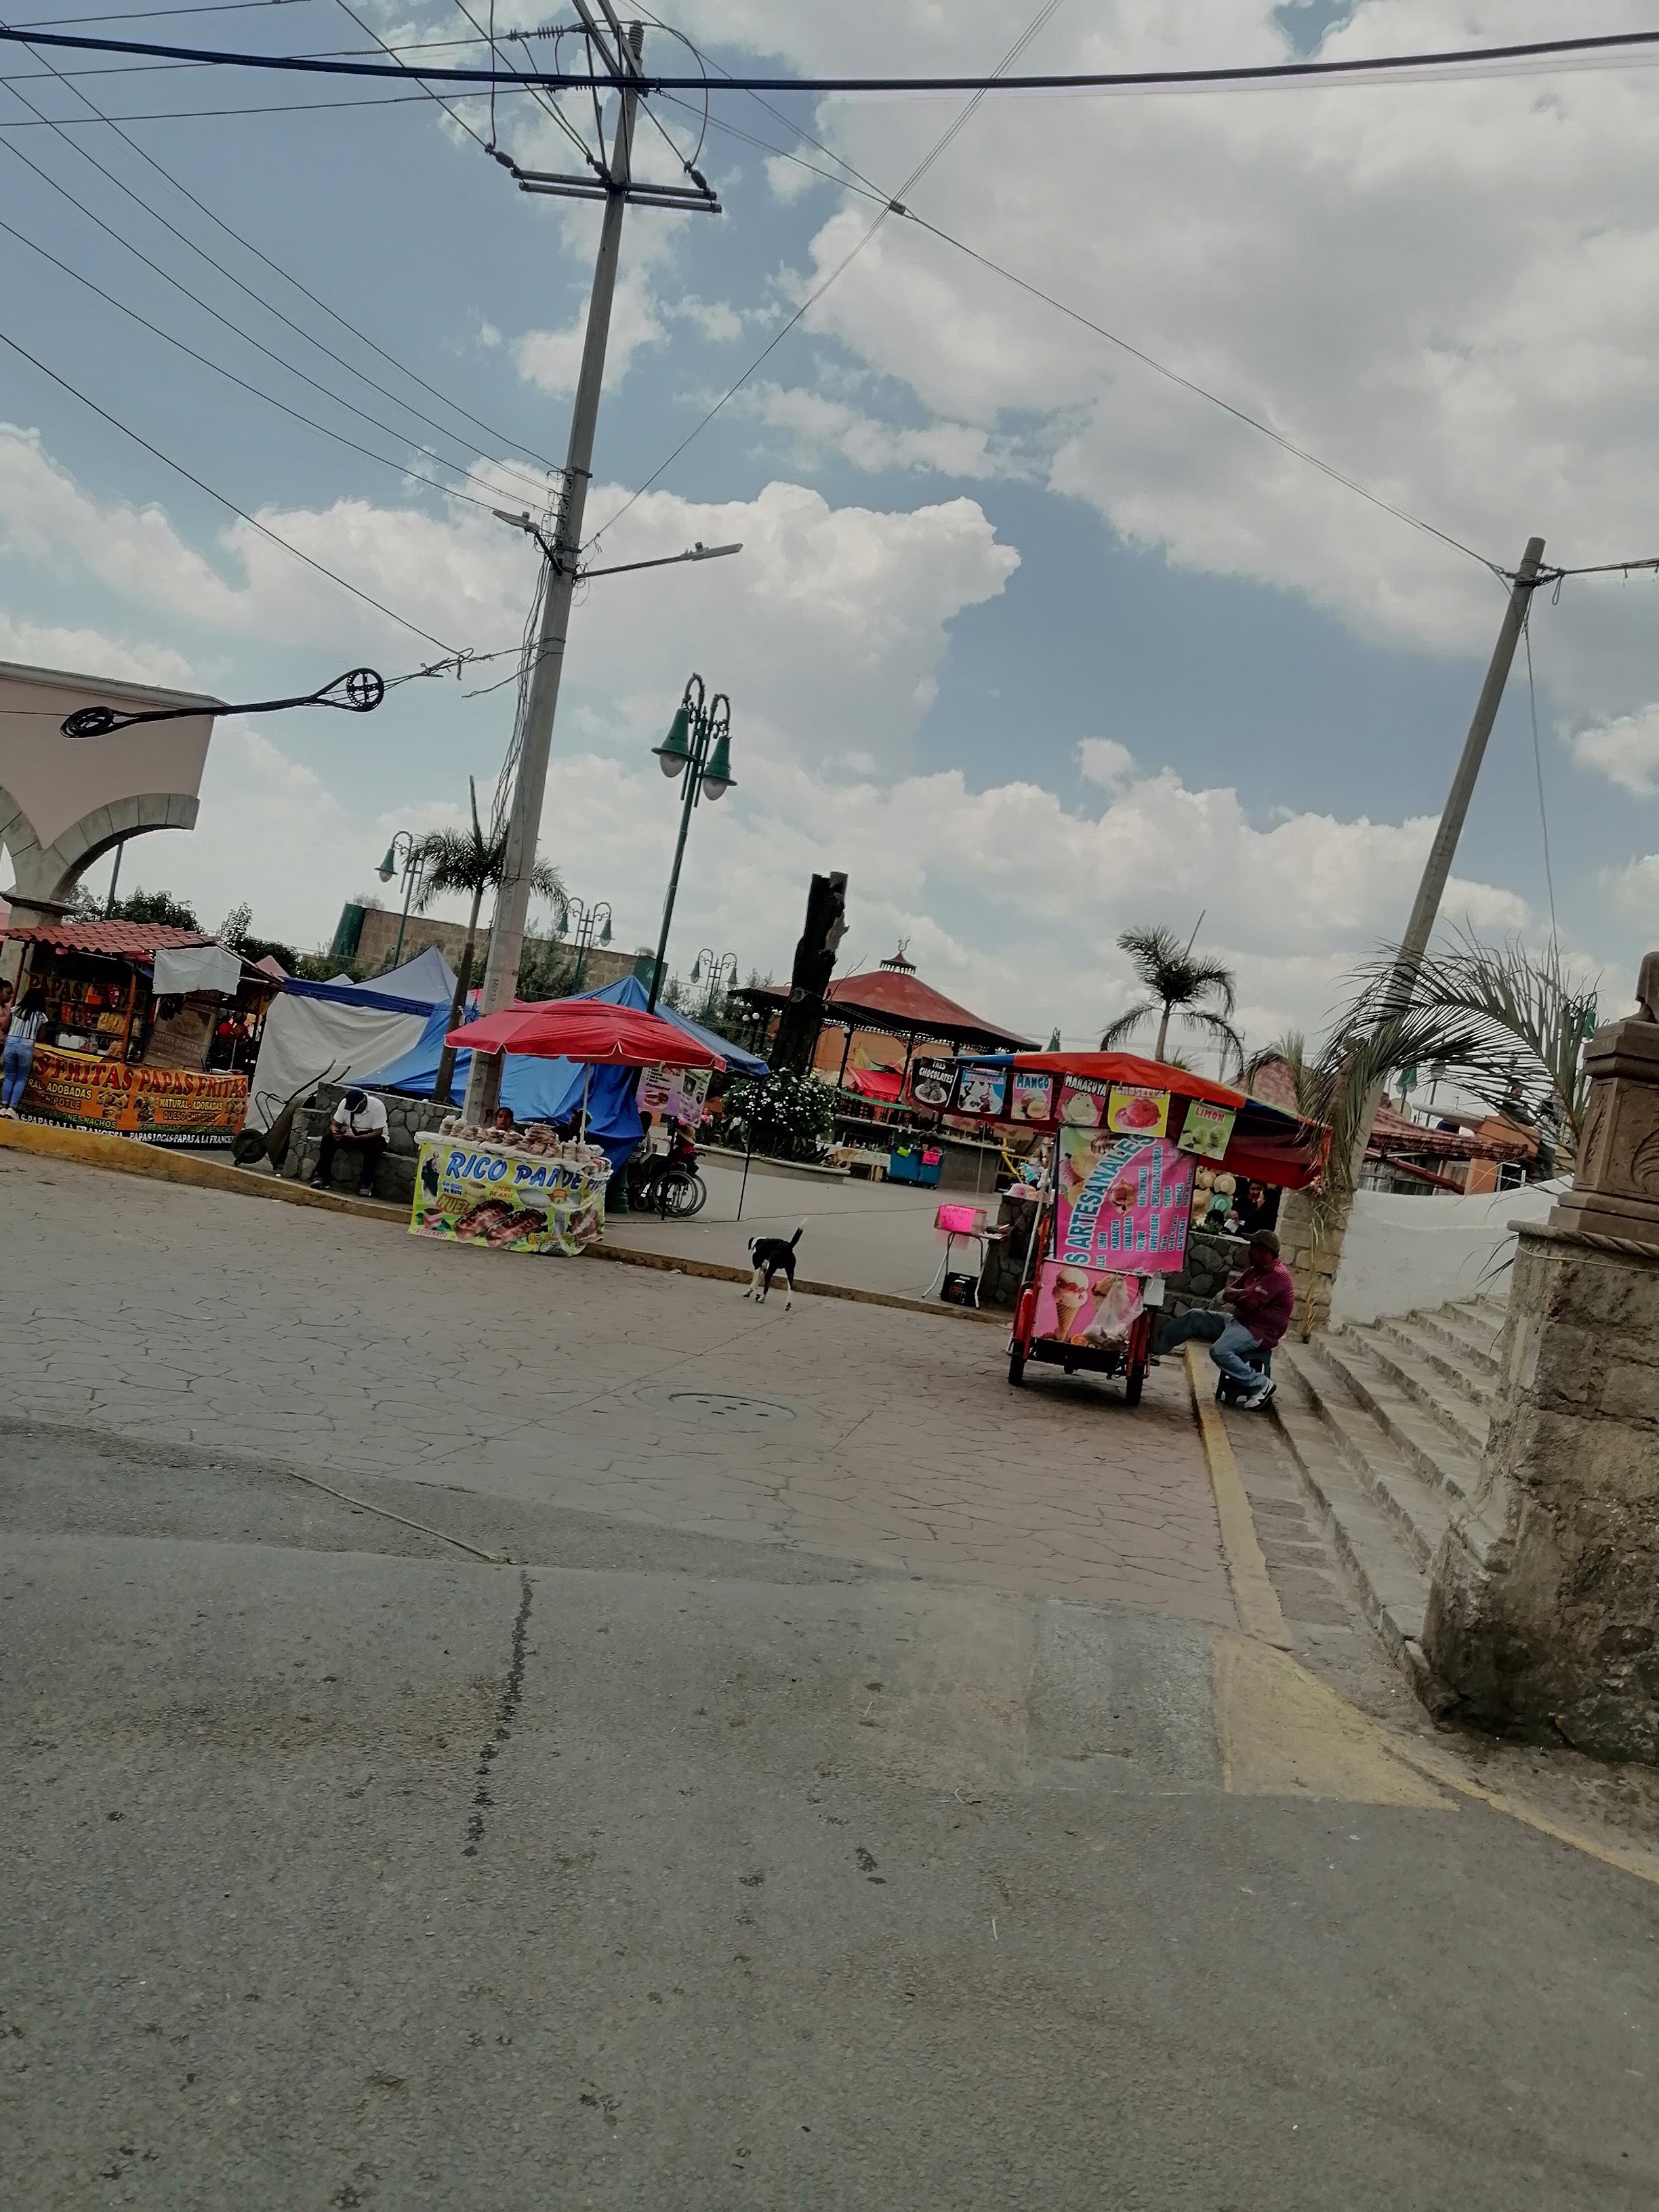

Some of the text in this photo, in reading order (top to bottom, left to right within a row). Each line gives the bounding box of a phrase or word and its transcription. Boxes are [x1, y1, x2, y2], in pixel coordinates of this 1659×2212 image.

[932, 1060, 946, 1071] TRES
[51, 1059, 134, 1091] FRITAS
[918, 1067, 954, 1084] CHOCOLATES
[1017, 1076, 1049, 1090] MANGO
[47, 1082, 92, 1100] ADOBADAS
[138, 1069, 247, 1099] PAPAS FRITAS
[1115, 1086, 1166, 1099] GROSELLA
[445, 1151, 507, 1181] RICO
[514, 1164, 562, 1187] PAN
[1139, 1167, 1147, 1183] PASAS
[492, 1185, 512, 1193] COCOL
[1067, 1134, 1156, 1249] ARTESANALES
[438, 1195, 469, 1214] NUEZ
